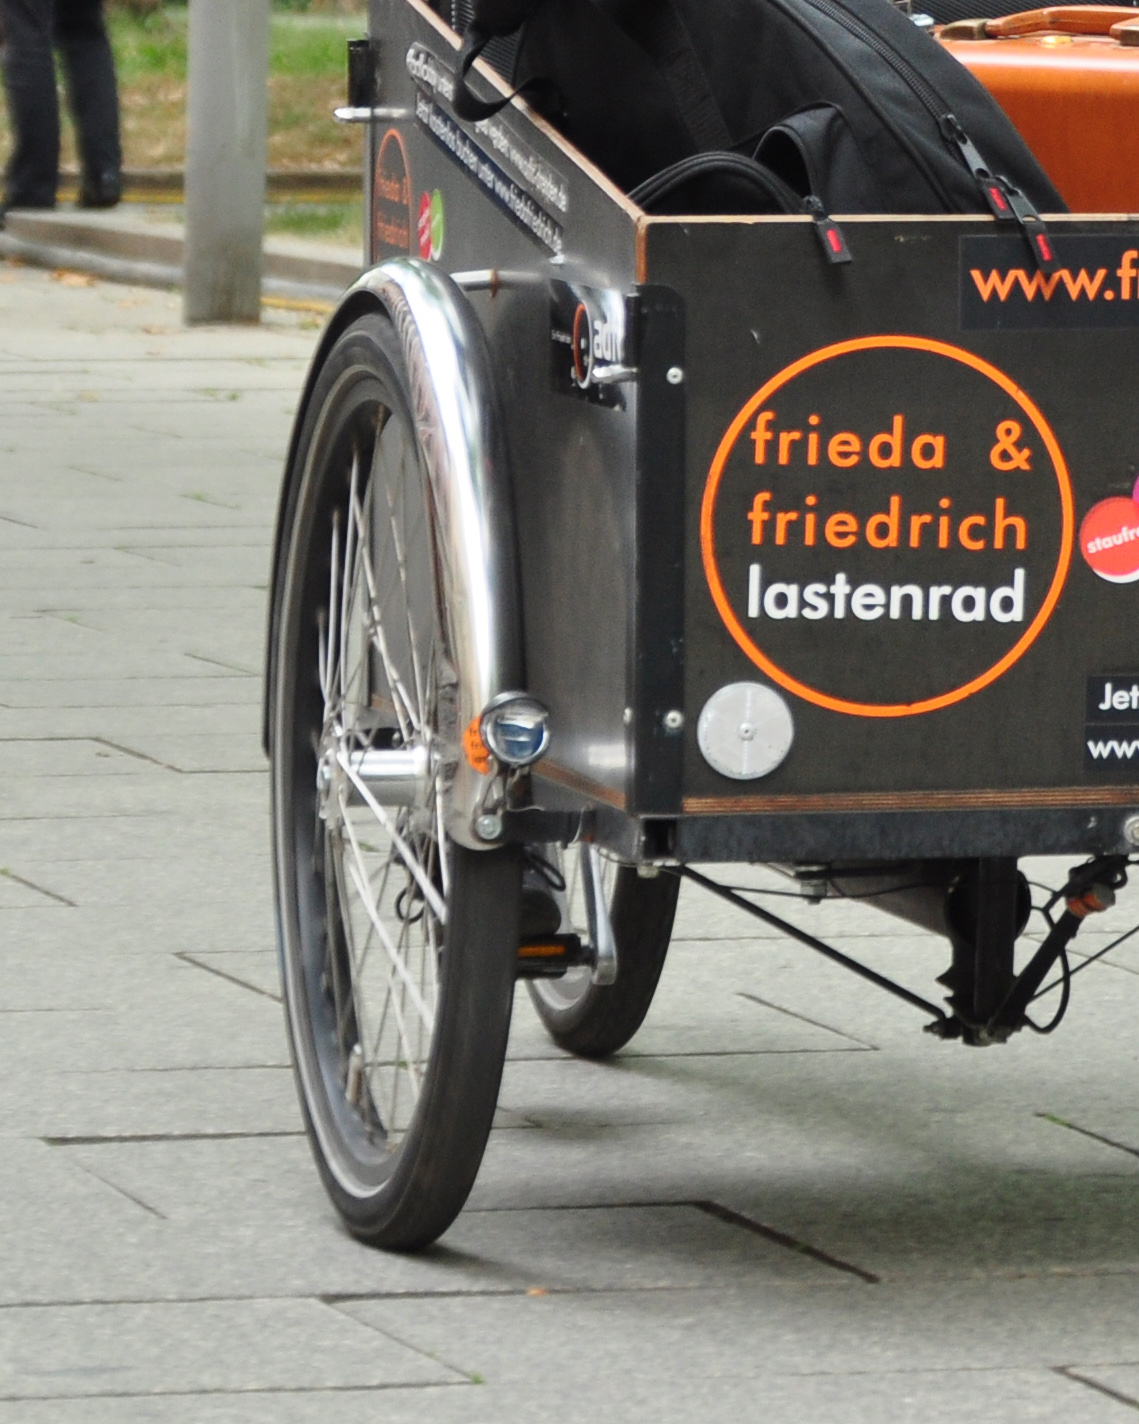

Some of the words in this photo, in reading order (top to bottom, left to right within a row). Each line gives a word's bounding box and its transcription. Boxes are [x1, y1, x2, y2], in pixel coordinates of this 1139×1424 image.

[750, 411, 947, 469] frieda
[990, 419, 1031, 471] &
[747, 491, 1028, 550] friedrich
[747, 563, 1026, 622] lastenrad
